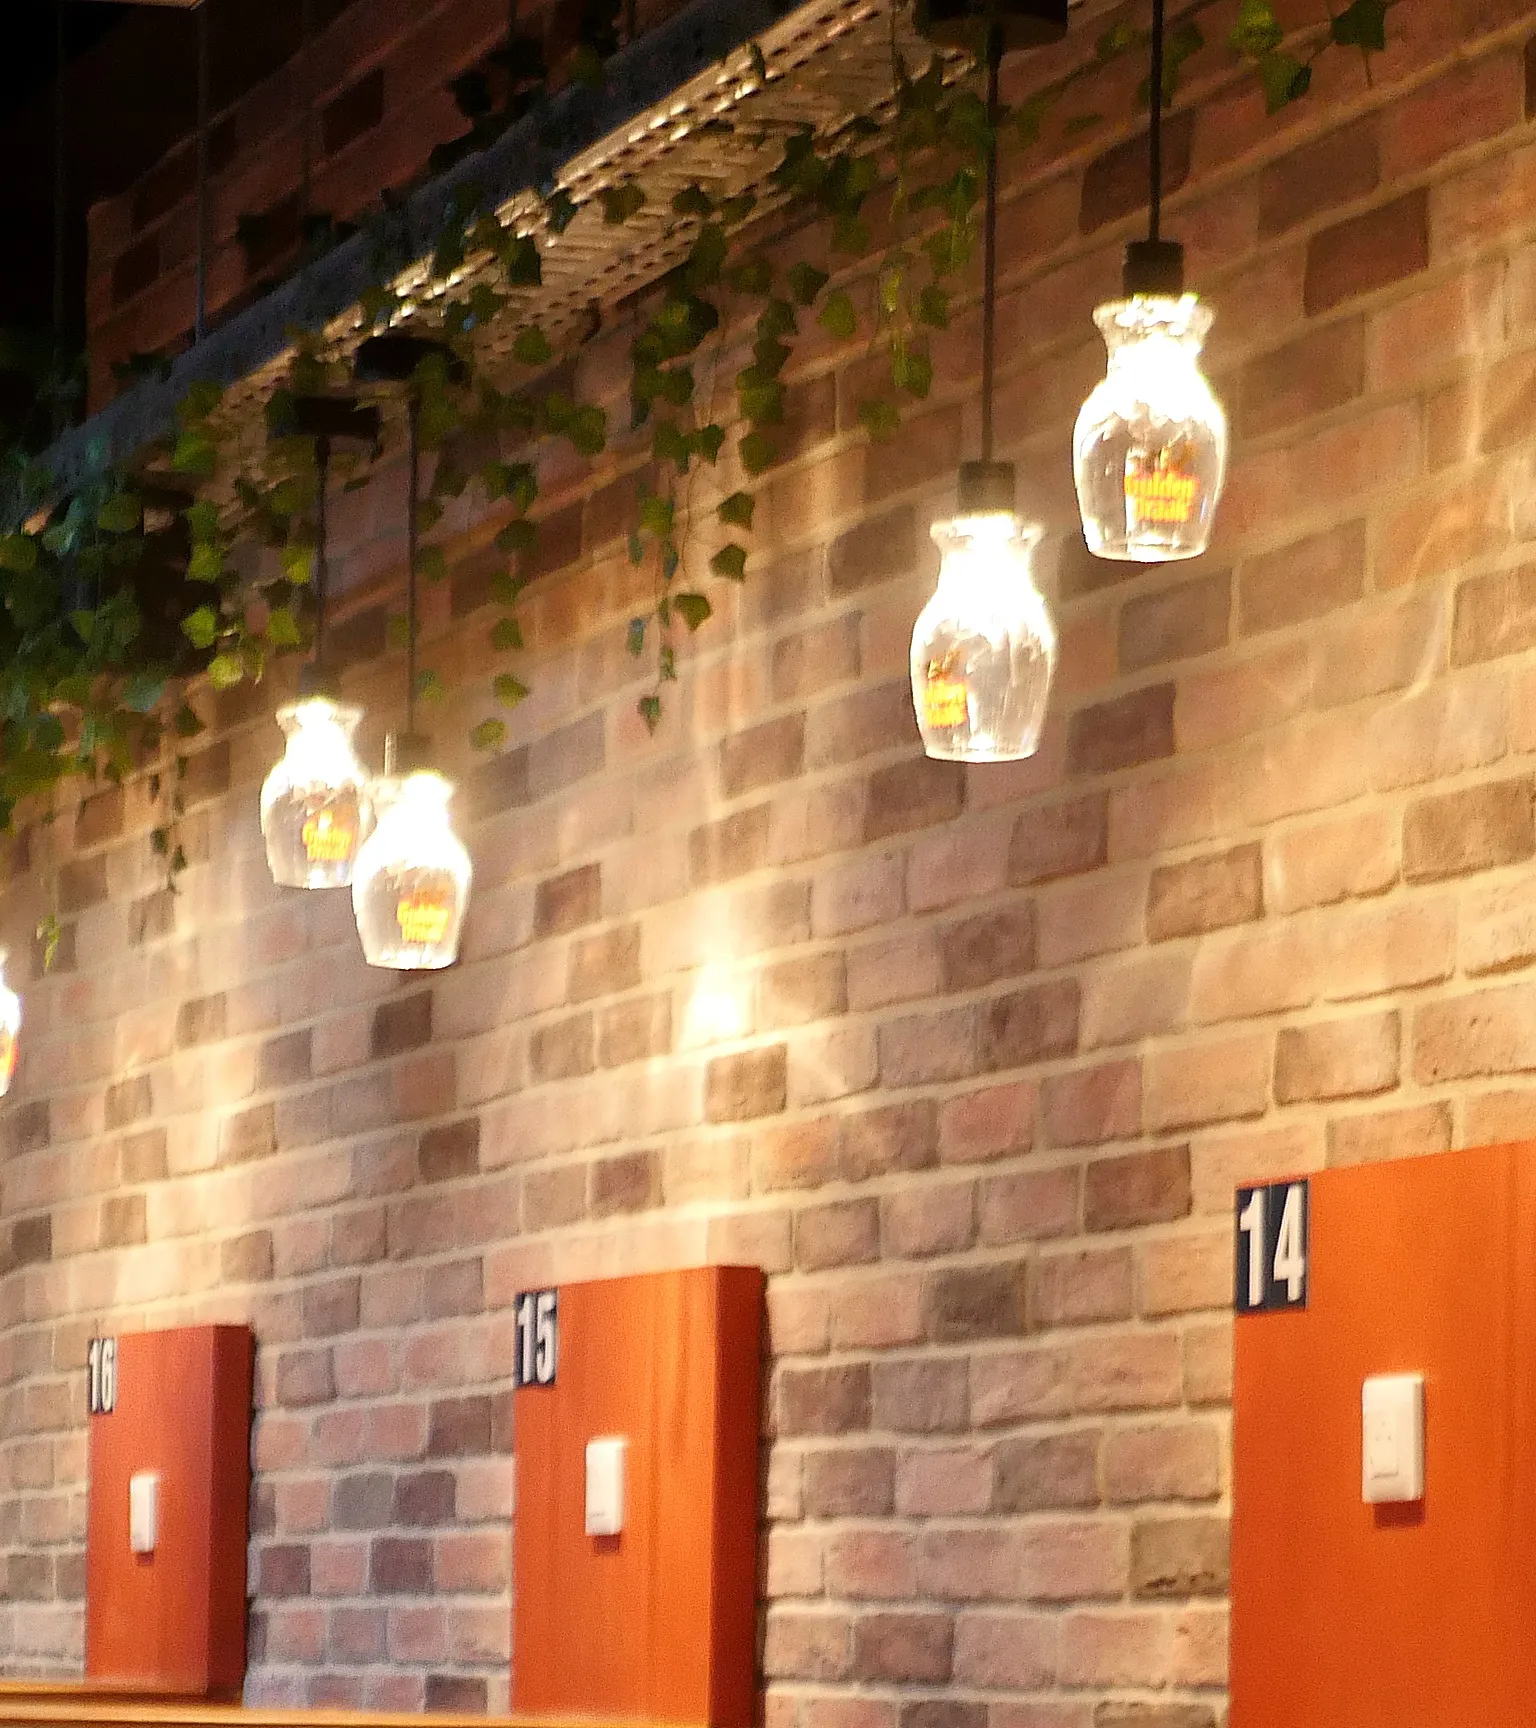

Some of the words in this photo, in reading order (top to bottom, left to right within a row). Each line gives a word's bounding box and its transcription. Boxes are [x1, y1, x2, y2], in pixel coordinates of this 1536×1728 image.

[1239, 1184, 1306, 1307] 14
[88, 1339, 114, 1413] 16
[517, 1292, 556, 1384] 15
